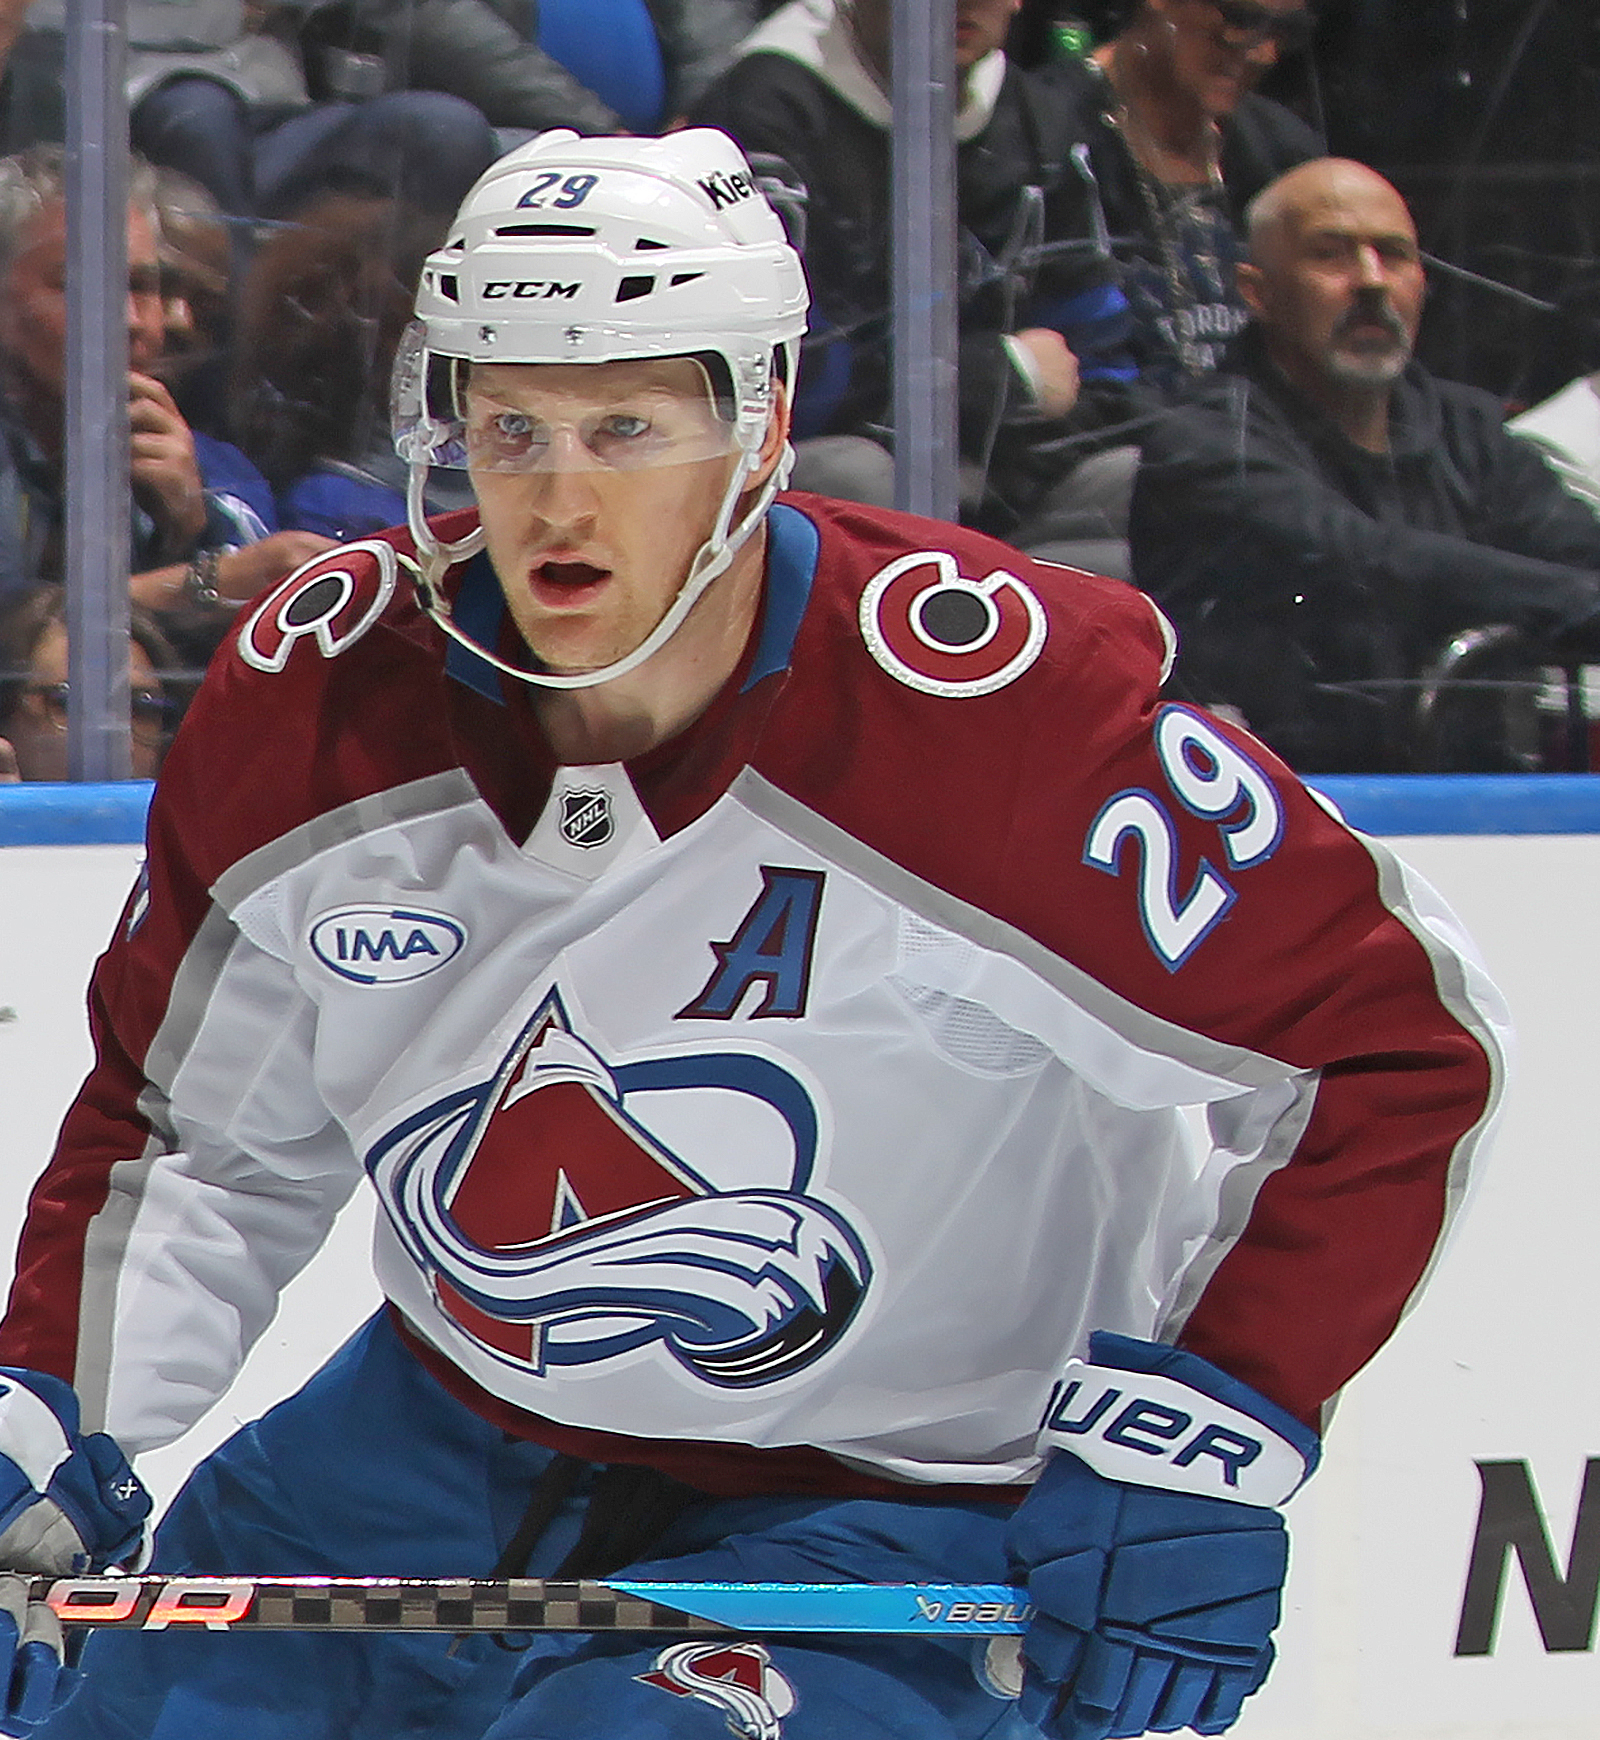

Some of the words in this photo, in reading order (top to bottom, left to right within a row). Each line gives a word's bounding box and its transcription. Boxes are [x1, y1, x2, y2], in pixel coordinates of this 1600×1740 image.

[515, 172, 600, 210] 29
[482, 282, 582, 299] CCM
[1081, 702, 1286, 974] 29
[335, 927, 442, 962] IMA
[673, 865, 827, 1021] A
[1039, 1379, 1263, 1488] UER
